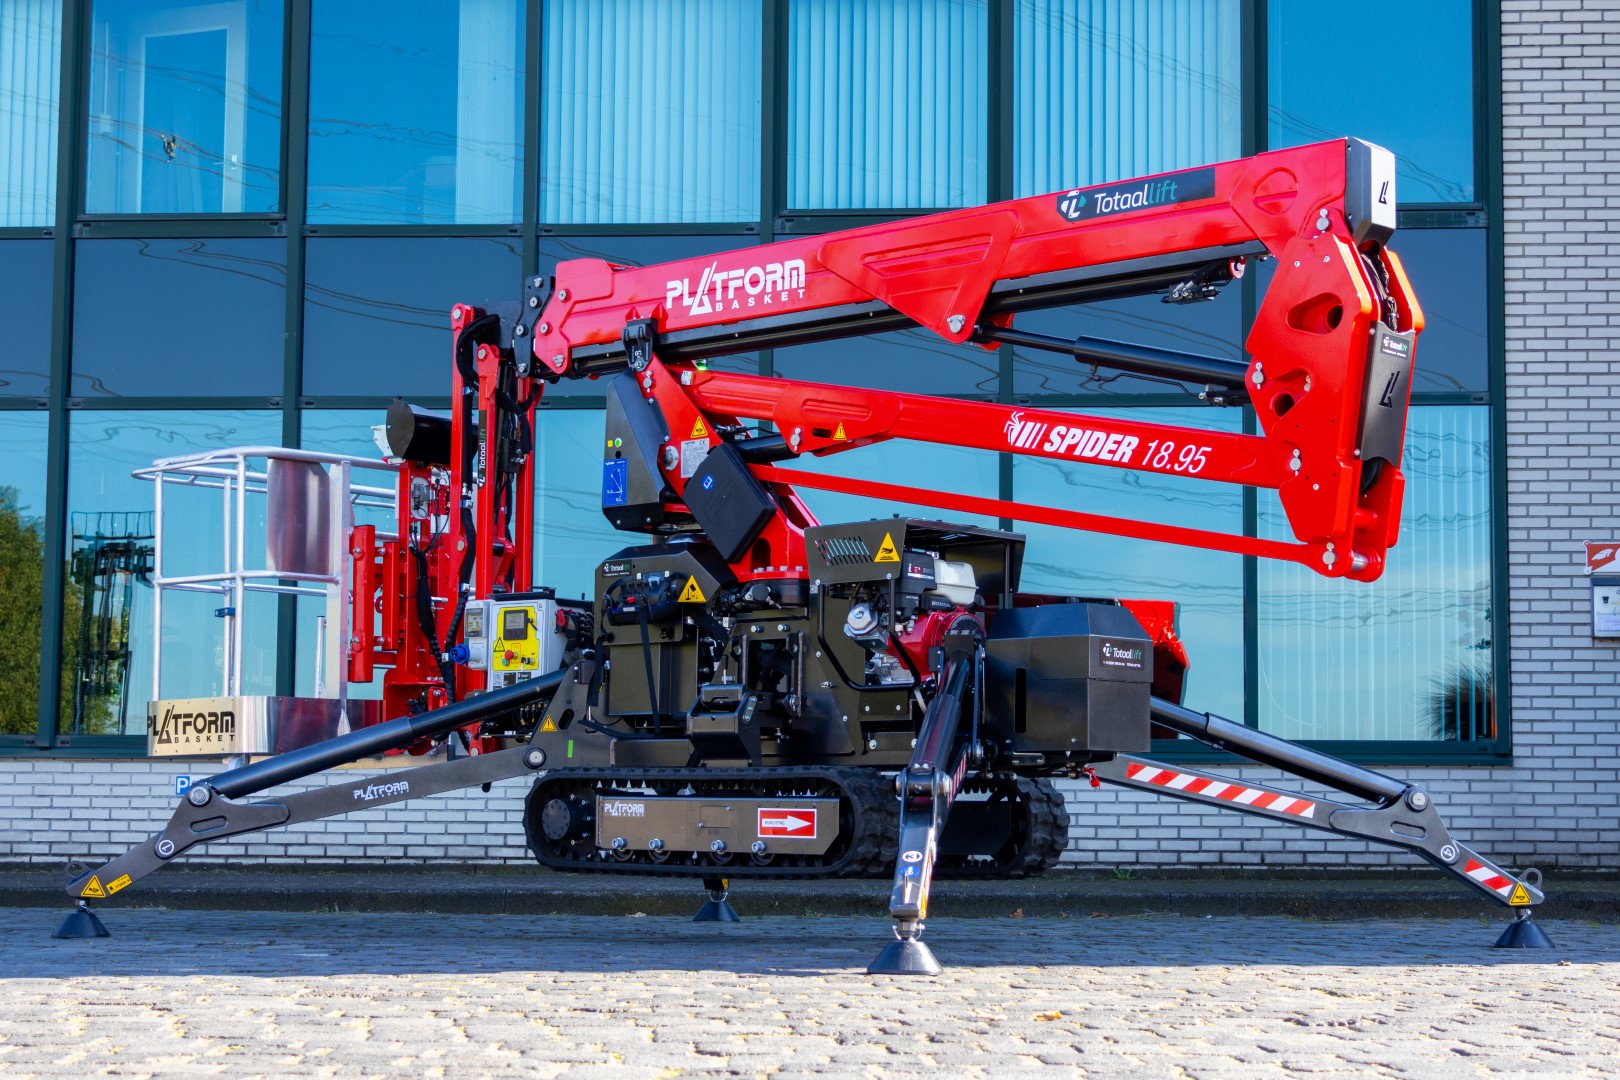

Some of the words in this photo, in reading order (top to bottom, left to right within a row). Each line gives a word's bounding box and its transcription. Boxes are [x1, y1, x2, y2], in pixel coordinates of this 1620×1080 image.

[1094, 180, 1178, 214] Totaallift
[666, 258, 806, 316] PLATFORM
[715, 288, 806, 312] BASKET
[1043, 425, 1140, 463] SPIDER
[1142, 439, 1213, 474] 18.95
[147, 705, 235, 744] PLATFORM
[174, 734, 235, 743] BASKET
[176, 777, 189, 794] P
[353, 781, 409, 800] PLATFORM
[604, 801, 644, 816] PLATFORM
